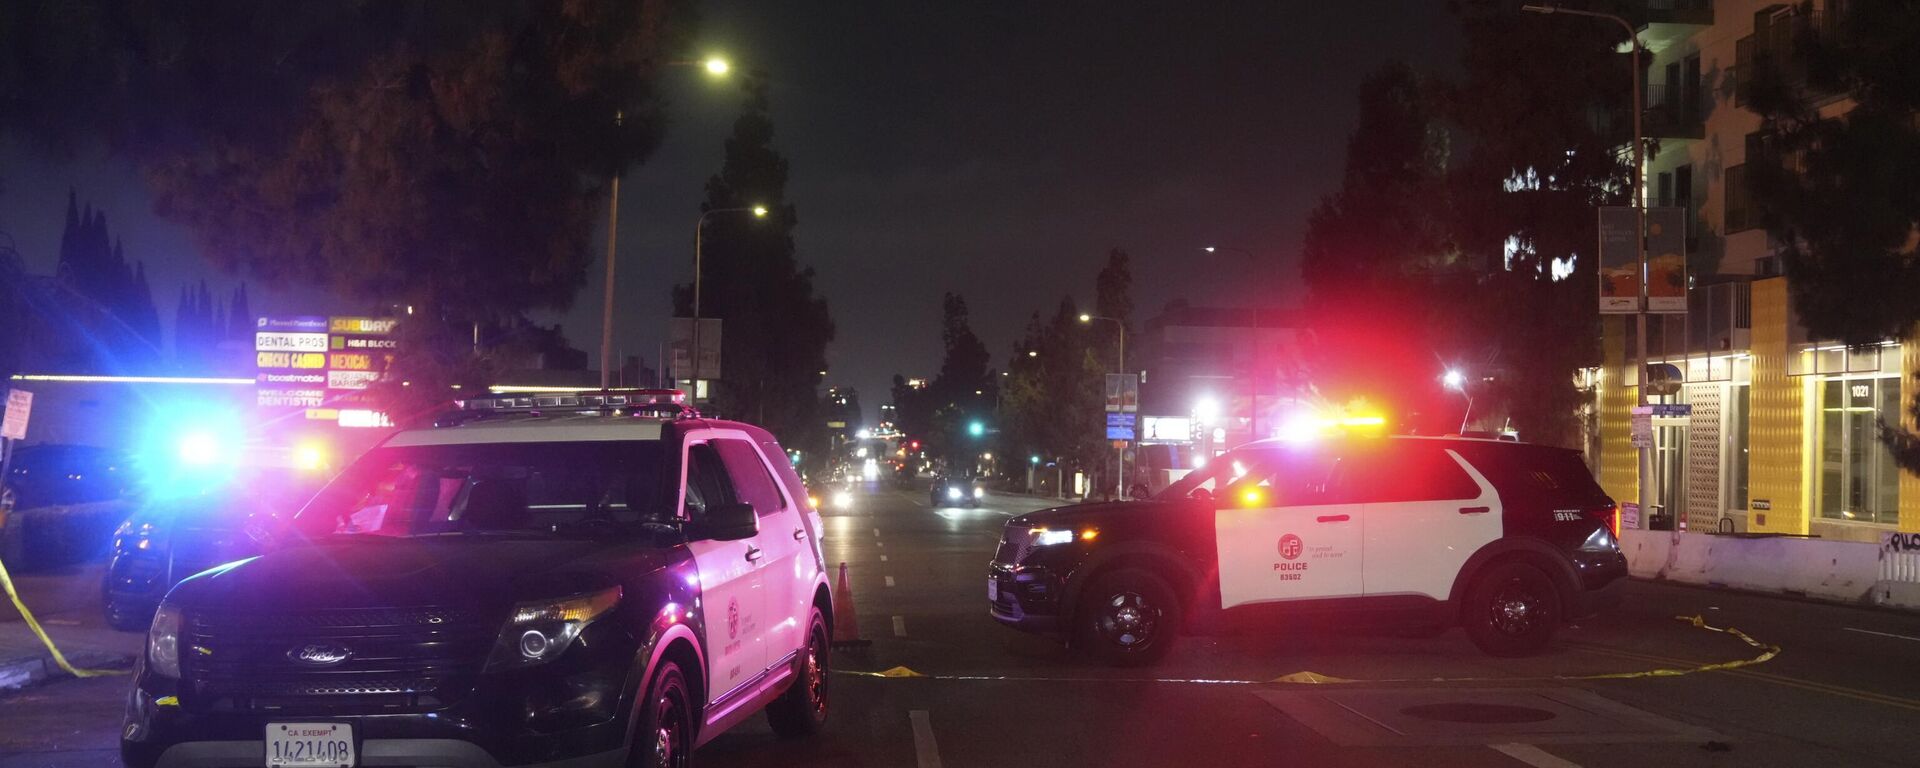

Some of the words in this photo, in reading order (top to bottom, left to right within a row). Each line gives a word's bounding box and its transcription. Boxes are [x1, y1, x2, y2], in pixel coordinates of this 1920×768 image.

[331, 319, 395, 331] SUBWAY
[258, 336, 295, 347] DENTAL
[299, 337, 325, 347] PROS
[347, 339, 366, 348] H&R
[368, 340, 397, 348] BLOCK
[1851, 385, 1869, 397] 1021
[257, 397, 324, 407] DENTISTRY
[1273, 562, 1308, 571] POLICE
[299, 644, 339, 662] Ford
[287, 729, 299, 737] CA
[302, 729, 332, 737] EXEMPT
[273, 740, 349, 762] 1421408
